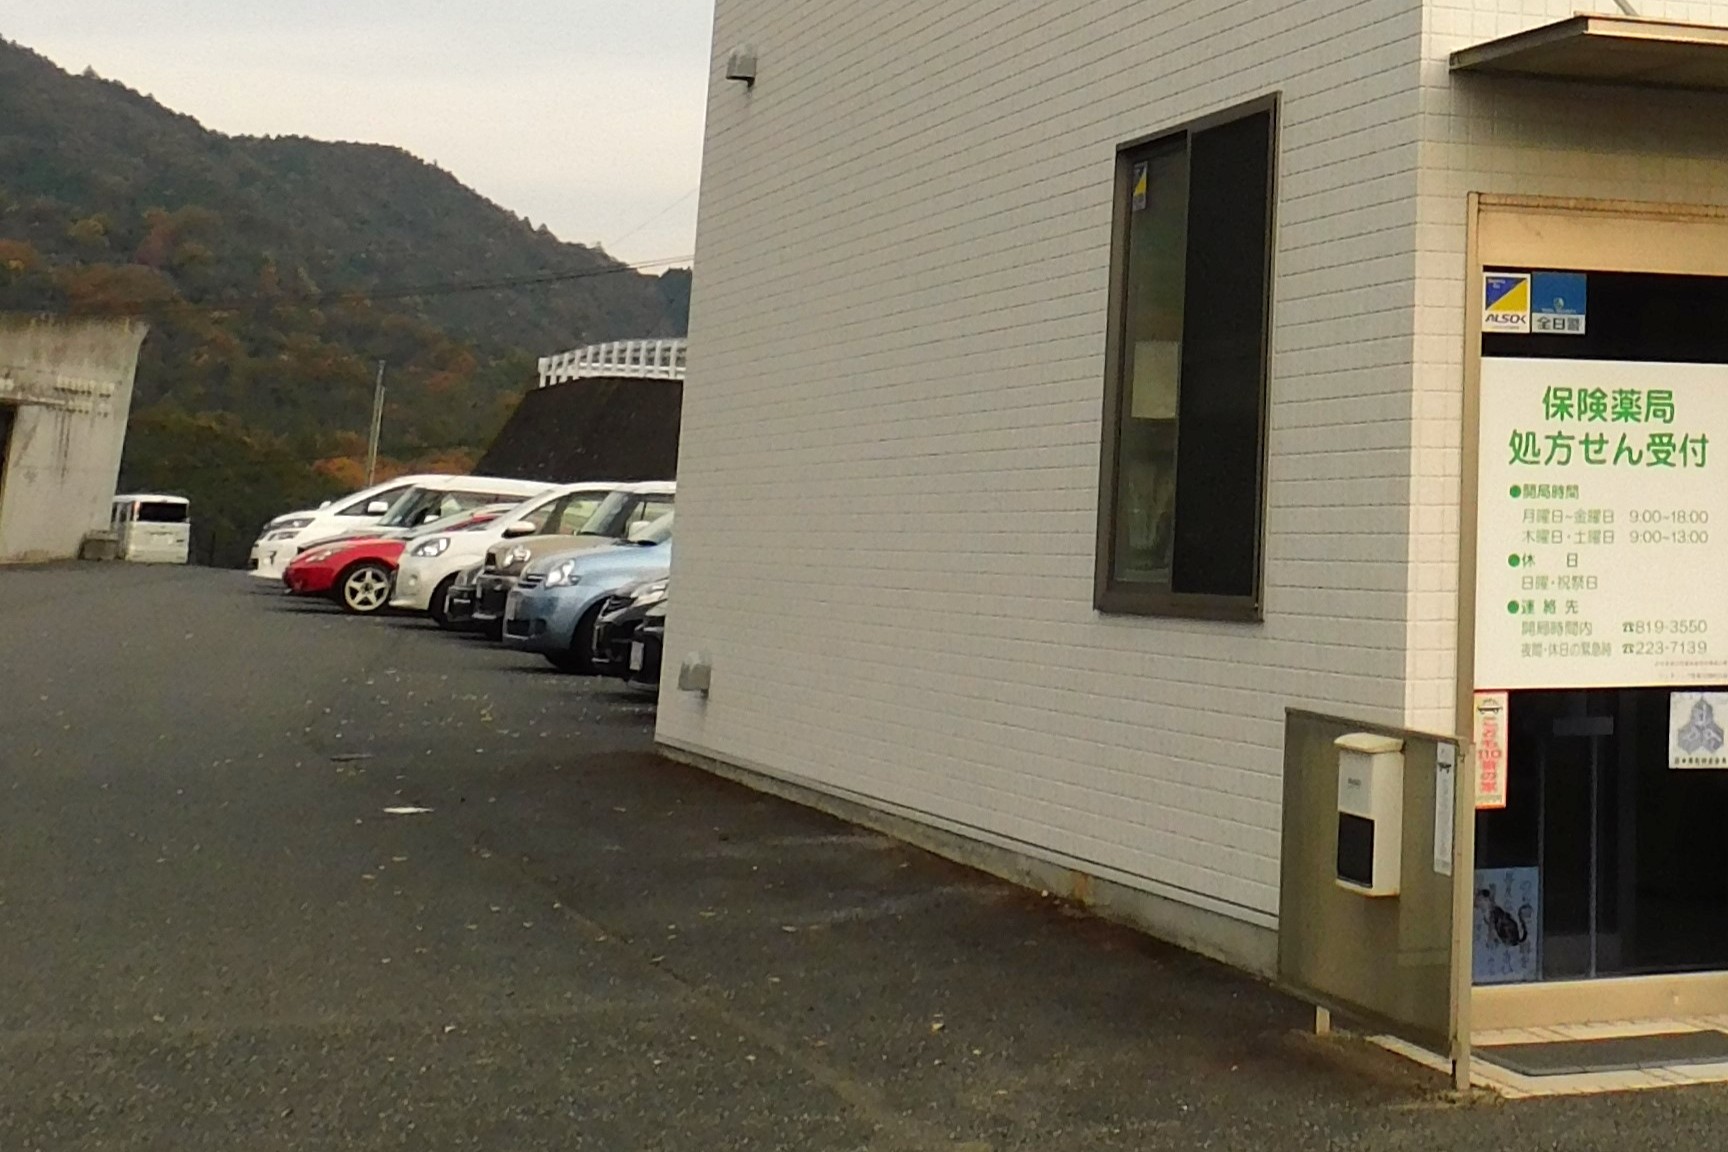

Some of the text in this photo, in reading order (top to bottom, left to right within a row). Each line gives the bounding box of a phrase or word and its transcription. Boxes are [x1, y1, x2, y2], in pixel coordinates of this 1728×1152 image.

[1485, 313, 1526, 324] ALSOK
[1542, 385, 1675, 423] 保険薬局
[1508, 429, 1709, 467] 処方せん受付
